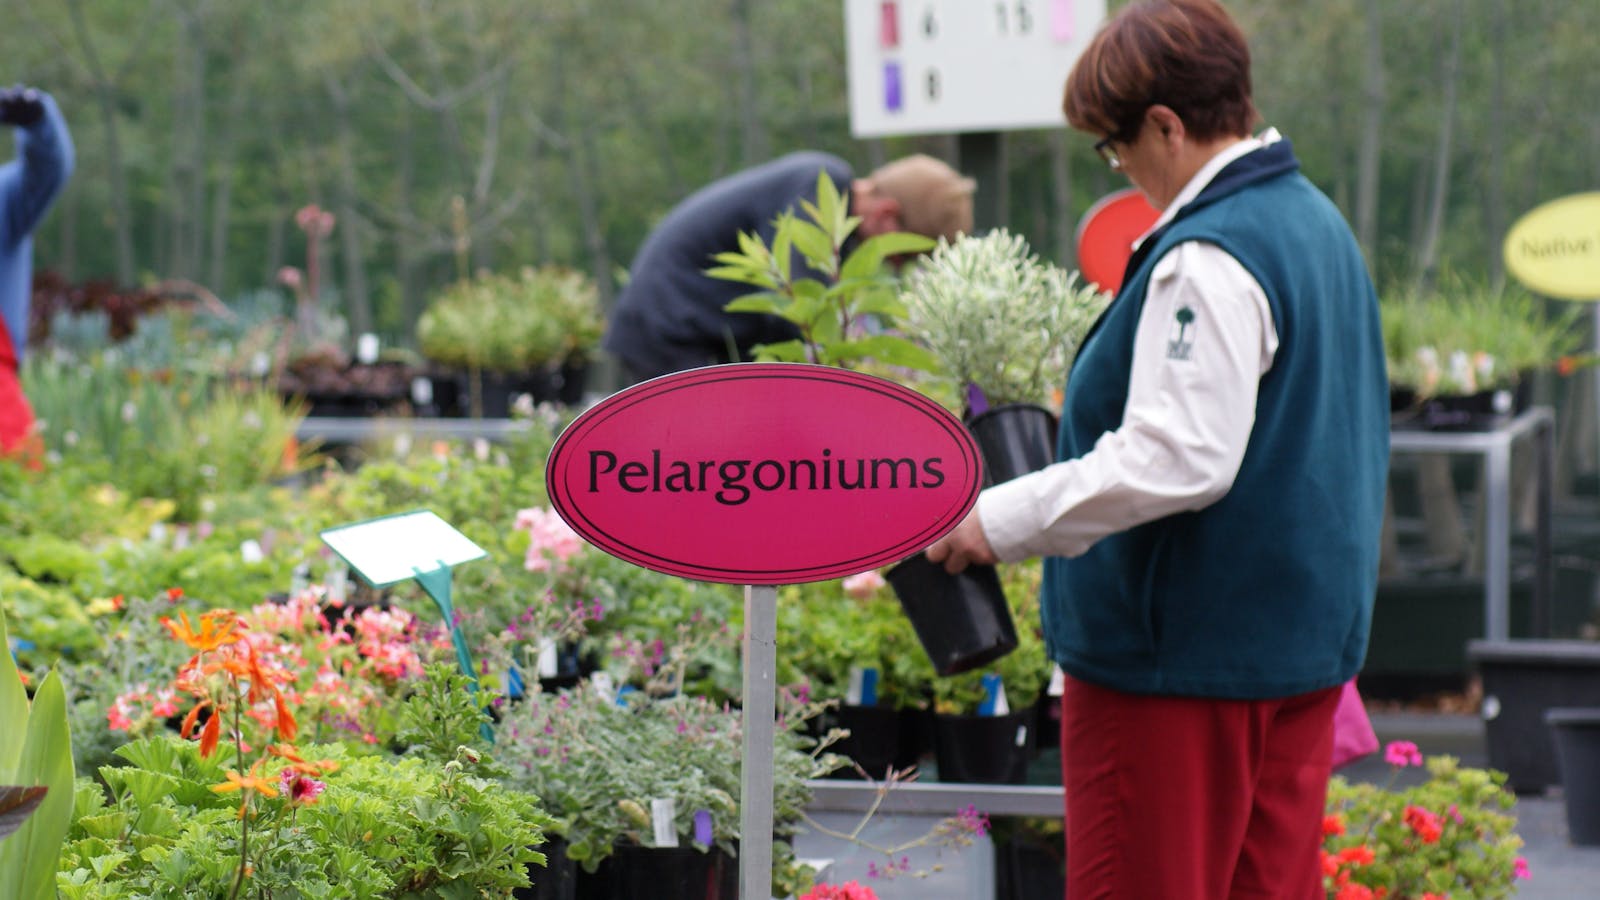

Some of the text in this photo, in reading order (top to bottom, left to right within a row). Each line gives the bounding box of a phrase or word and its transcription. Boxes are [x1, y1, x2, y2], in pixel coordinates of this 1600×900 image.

[921, 9, 936, 38] 6
[997, 2, 1033, 33] 15
[926, 71, 940, 101] 8
[1521, 237, 1591, 258] Native
[587, 448, 946, 506] Pelargoniums
